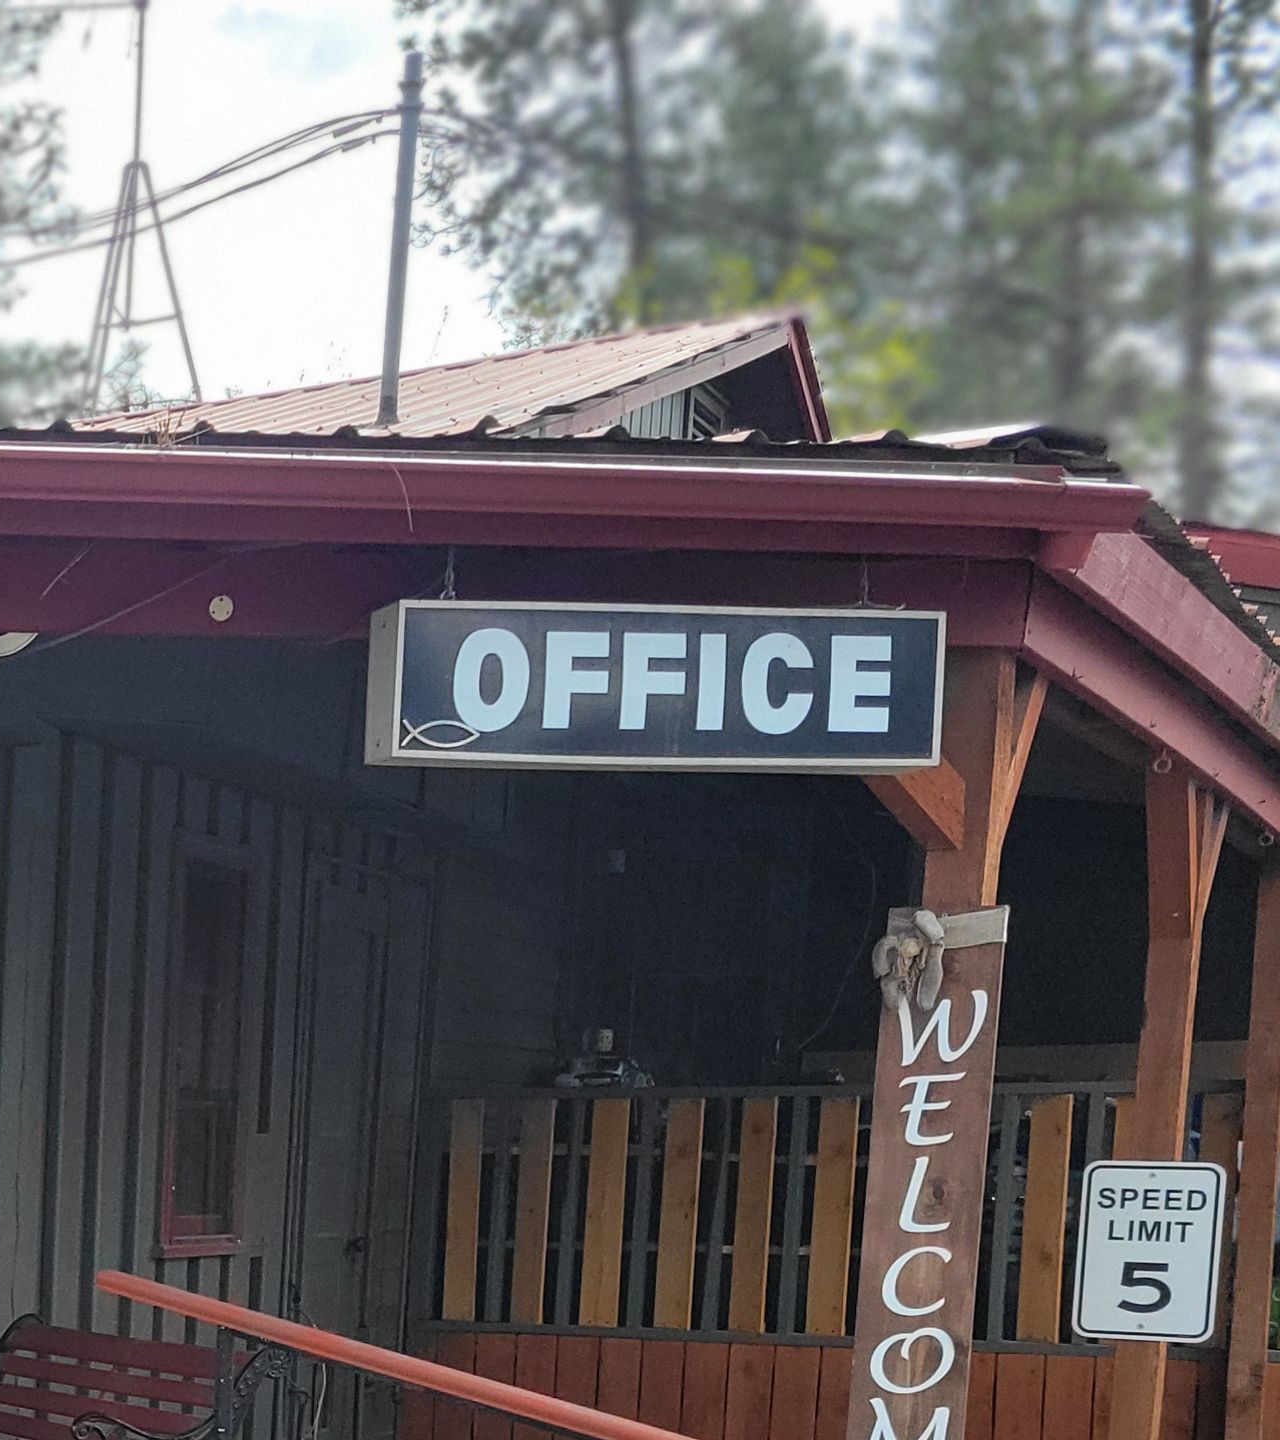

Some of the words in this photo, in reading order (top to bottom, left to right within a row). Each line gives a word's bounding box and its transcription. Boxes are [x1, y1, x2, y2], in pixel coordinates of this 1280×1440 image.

[453, 627, 892, 735] OFFICE
[1097, 1187, 1208, 1212] SPEED
[1107, 1220, 1195, 1243] LIMIT
[1116, 1261, 1173, 1313] 5
